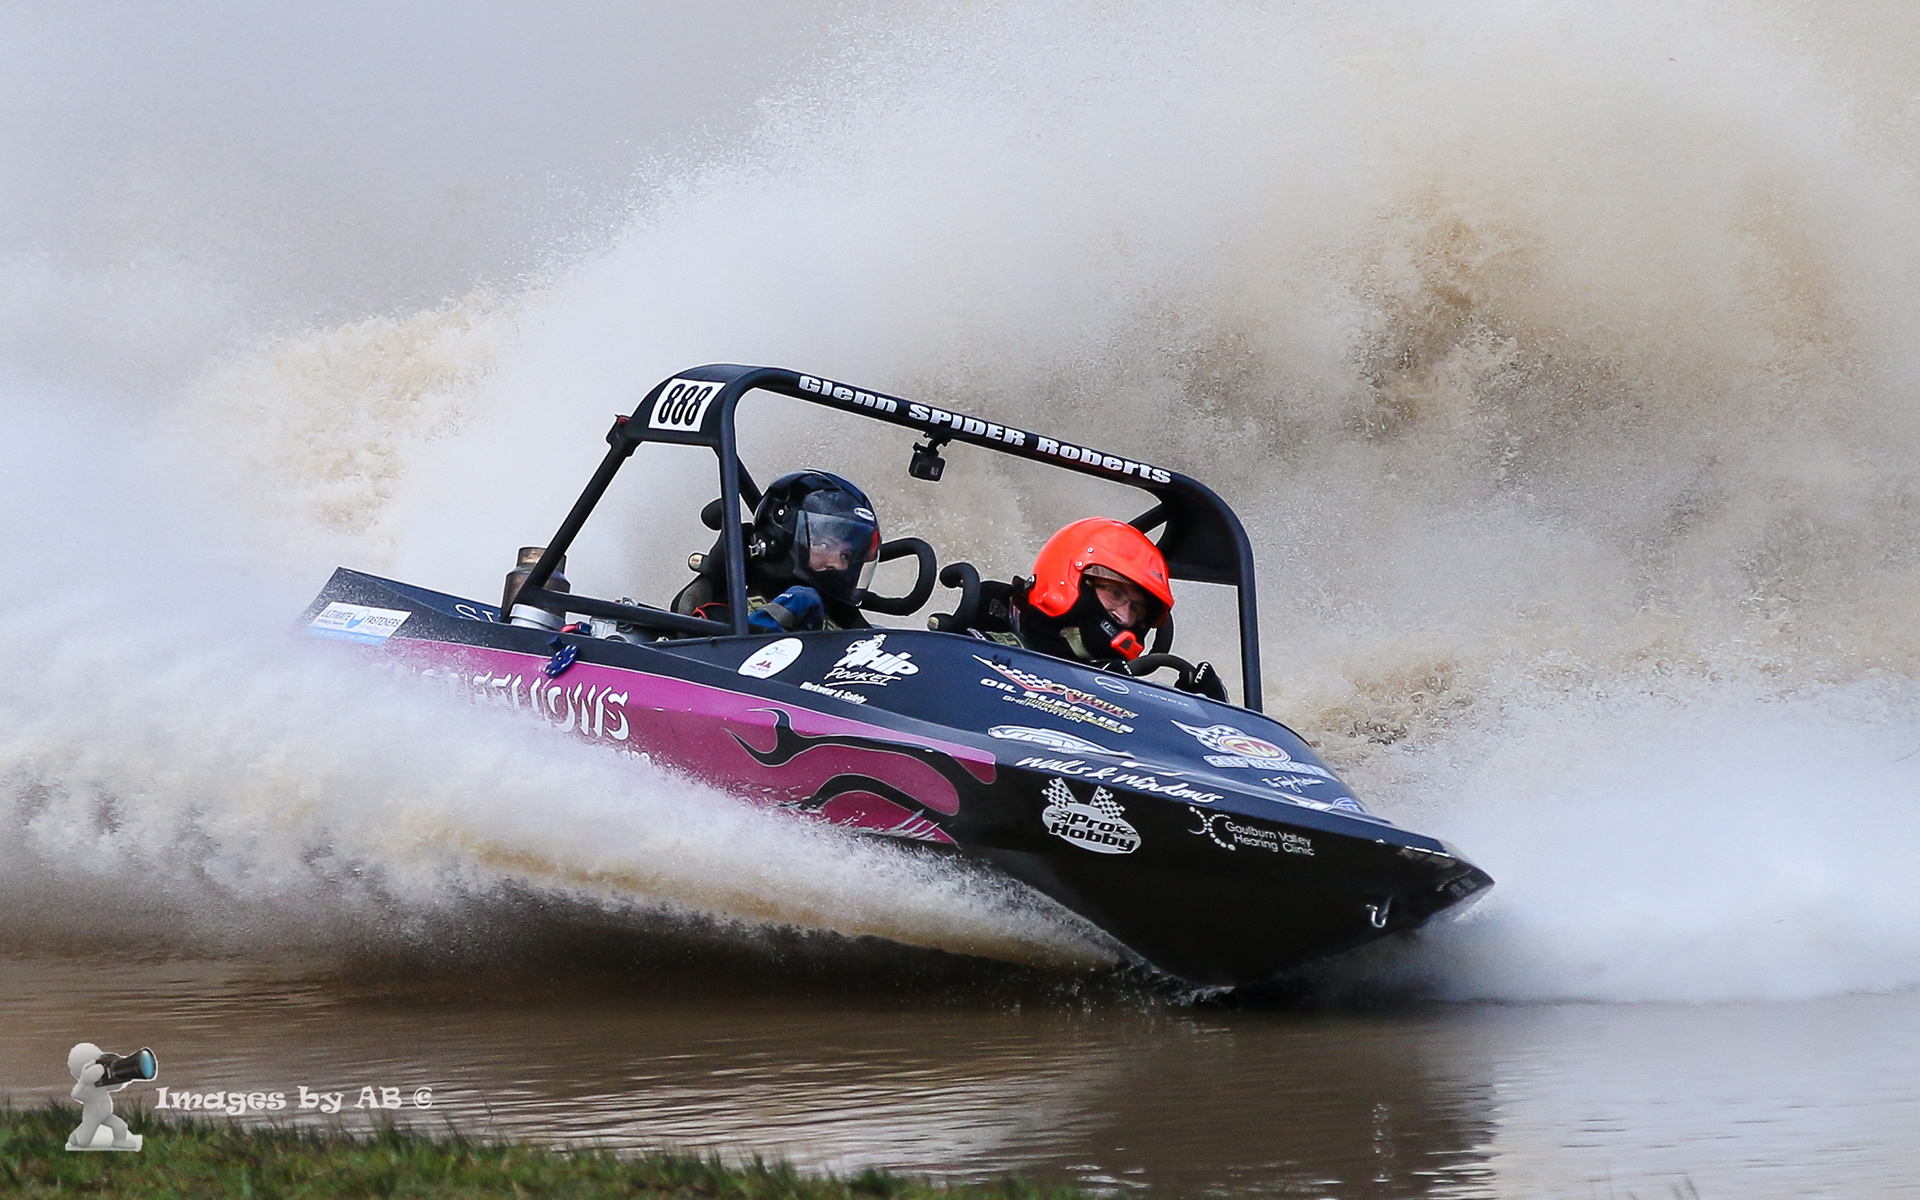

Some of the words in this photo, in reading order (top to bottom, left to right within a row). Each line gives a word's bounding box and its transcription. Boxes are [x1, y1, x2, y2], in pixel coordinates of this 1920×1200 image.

[656, 383, 712, 426] 888
[799, 374, 898, 413] Glenn
[908, 403, 1026, 446] SPIDER
[1036, 435, 1172, 484] Roberts
[980, 678, 1016, 693] OIL
[1023, 691, 1135, 733] SUPPLIES
[1050, 822, 1136, 852] Hobby
[1069, 813, 1115, 832] Pro
[1225, 821, 1277, 840] Goulburn
[1278, 831, 1311, 848] Valley
[1233, 833, 1278, 852] Hearing
[1282, 842, 1315, 856] Clinic
